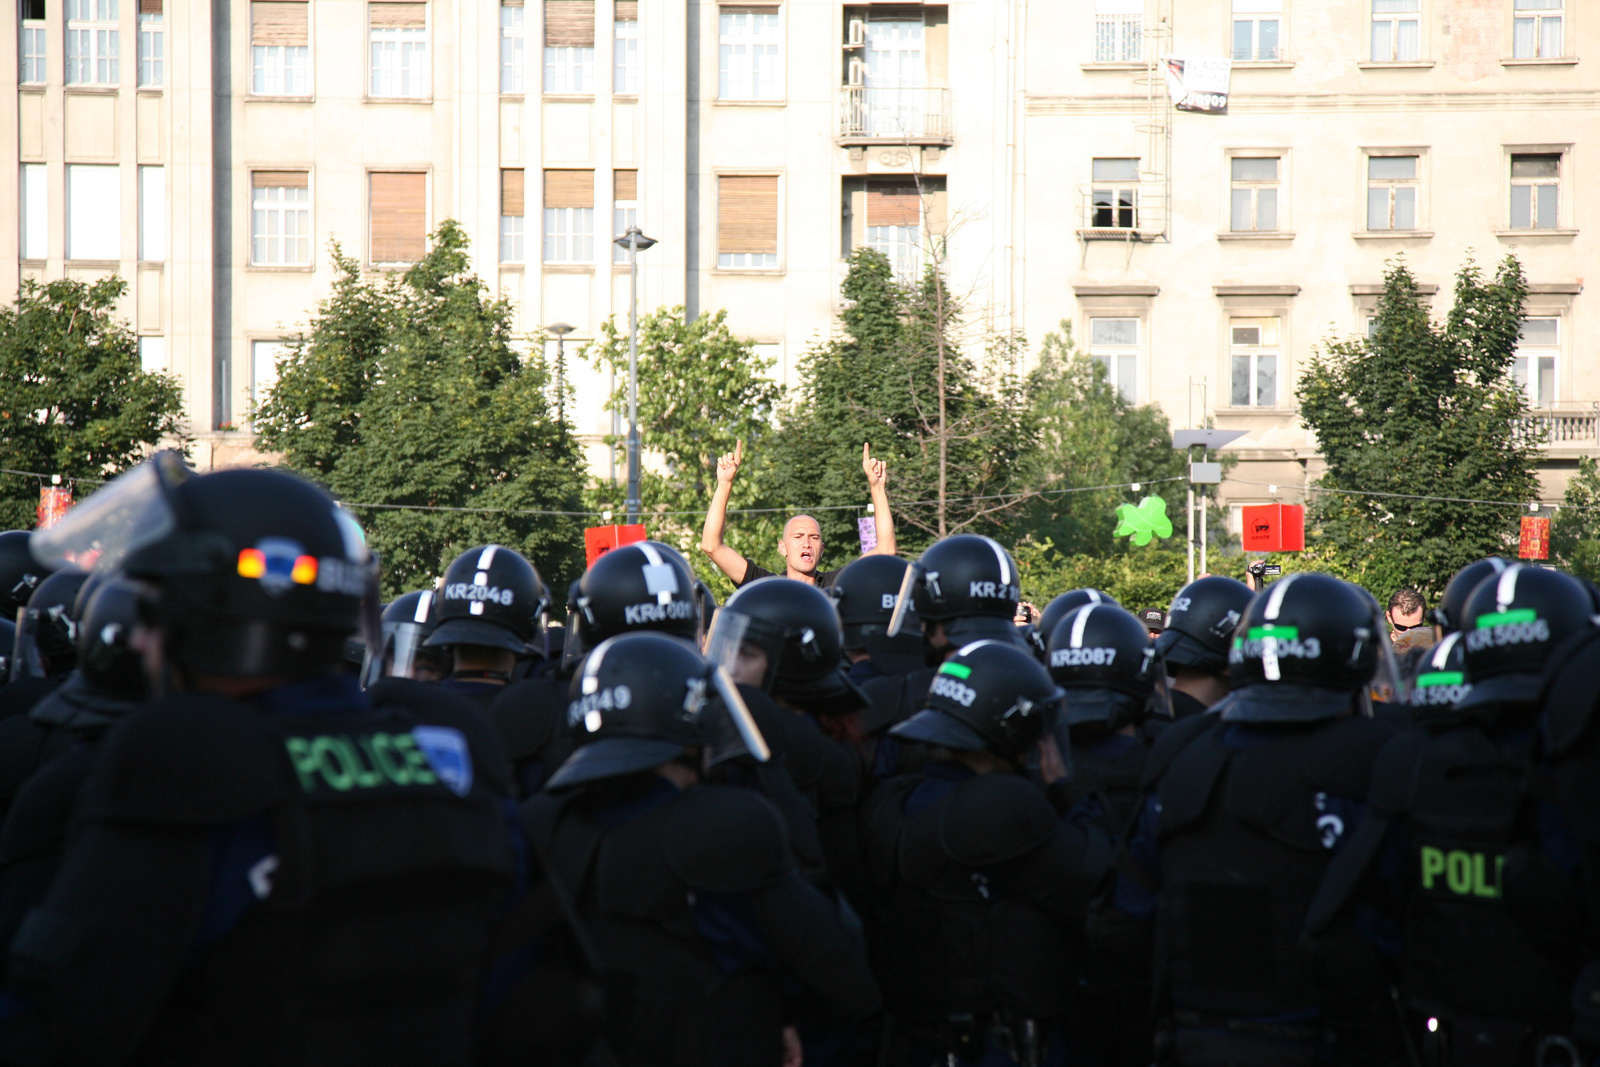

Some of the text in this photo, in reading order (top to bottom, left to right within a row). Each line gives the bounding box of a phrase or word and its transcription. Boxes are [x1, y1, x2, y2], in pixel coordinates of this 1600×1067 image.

[445, 583, 514, 606] KR2048
[1051, 648, 1116, 668] KR2087
[1244, 637, 1320, 658] KR043
[286, 733, 438, 792] POLICE
